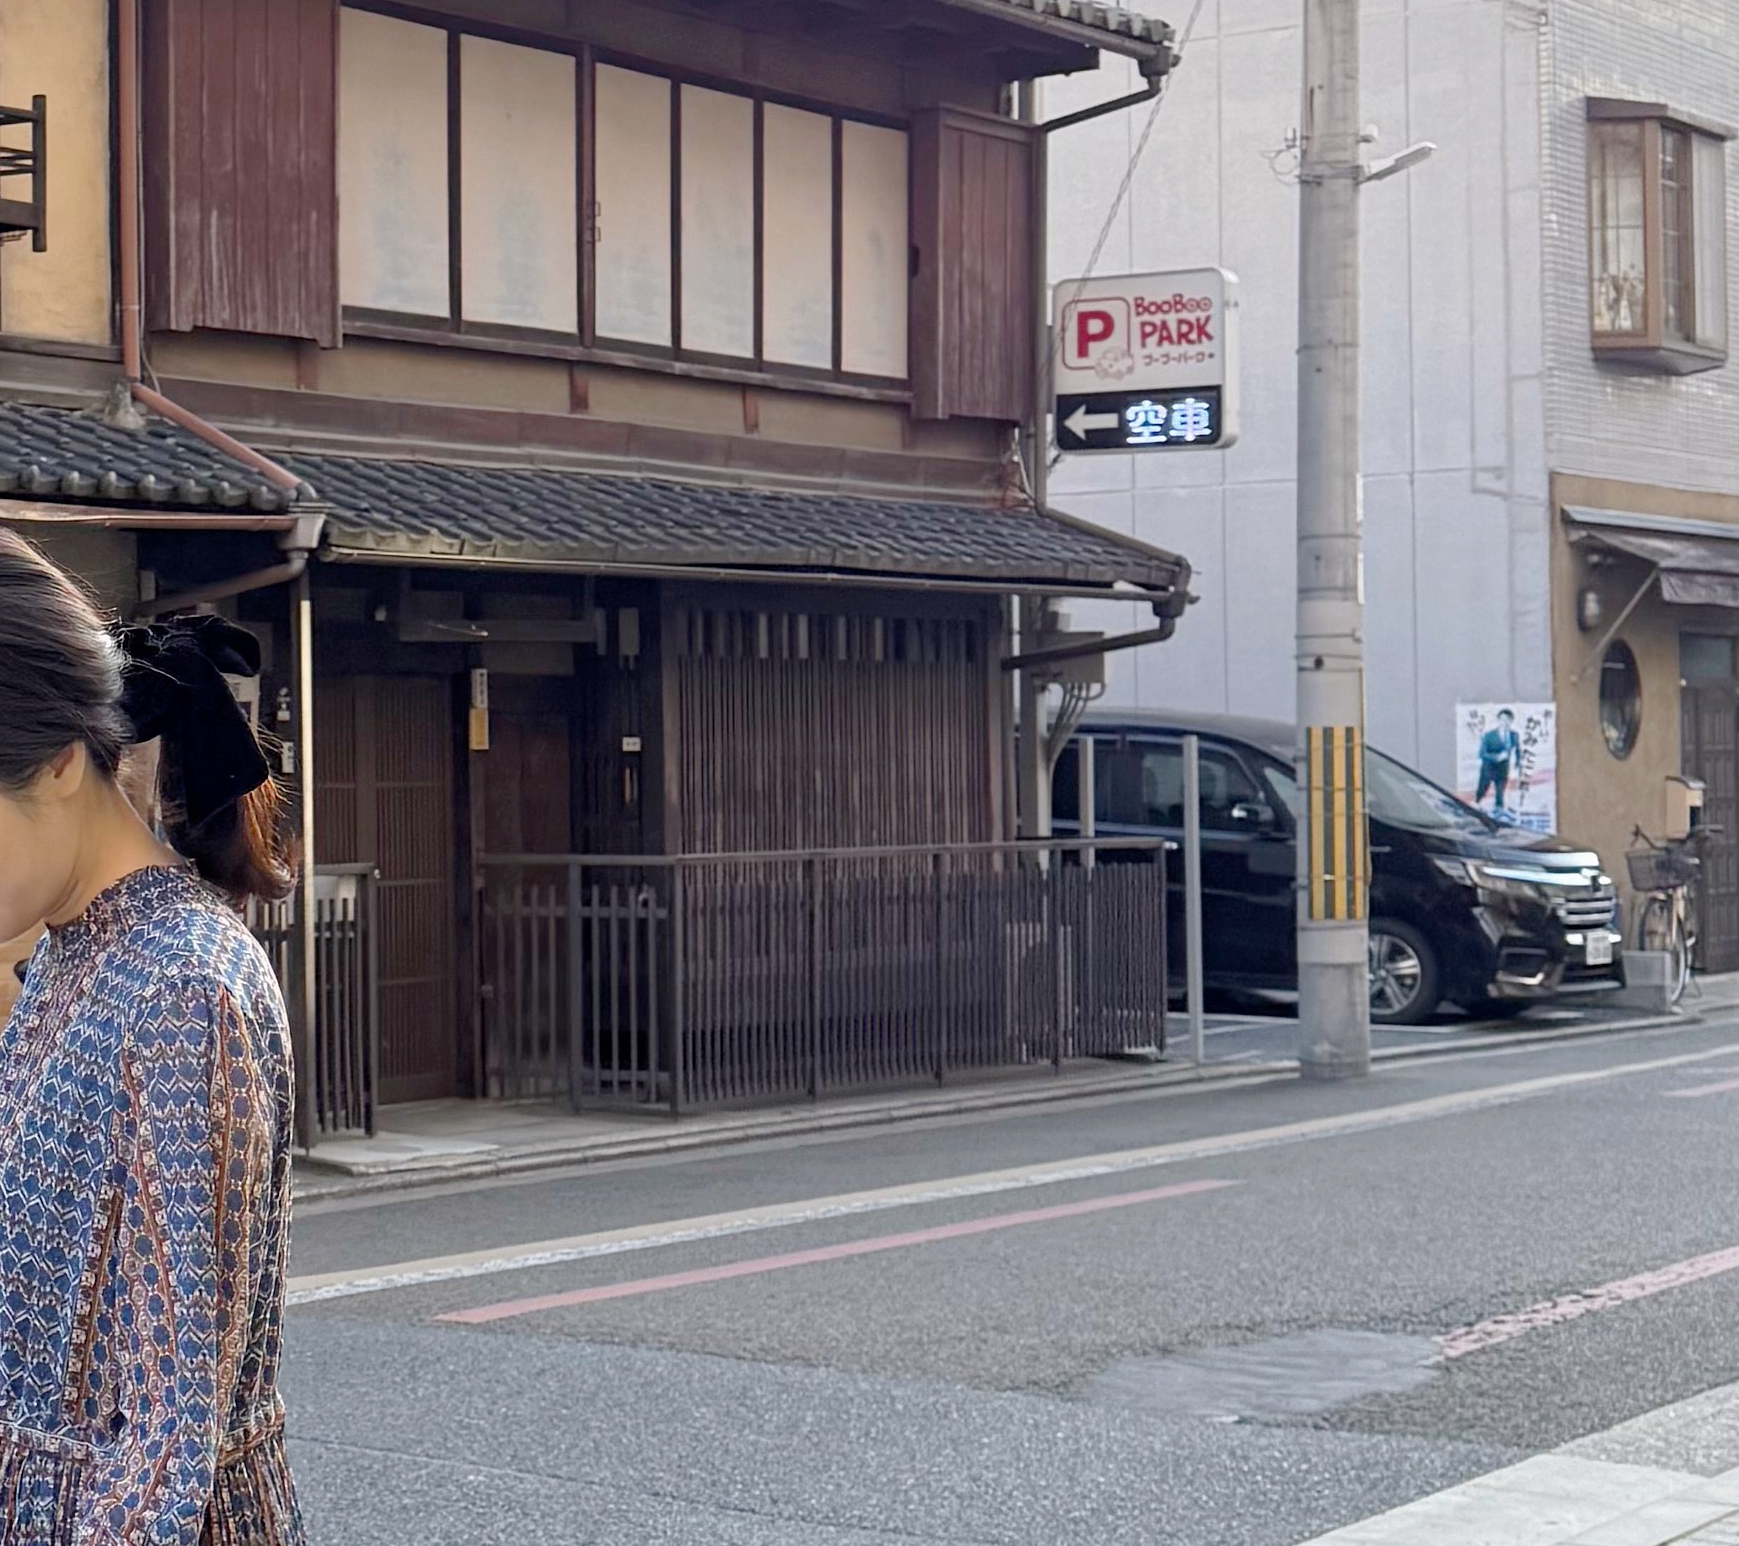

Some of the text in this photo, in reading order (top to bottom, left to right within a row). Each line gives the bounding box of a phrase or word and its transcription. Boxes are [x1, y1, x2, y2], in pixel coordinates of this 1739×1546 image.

[1133, 293, 1213, 317] BooBoo
[1076, 310, 1115, 359] P
[1140, 315, 1214, 349] PARK
[1125, 397, 1213, 445] 空車
